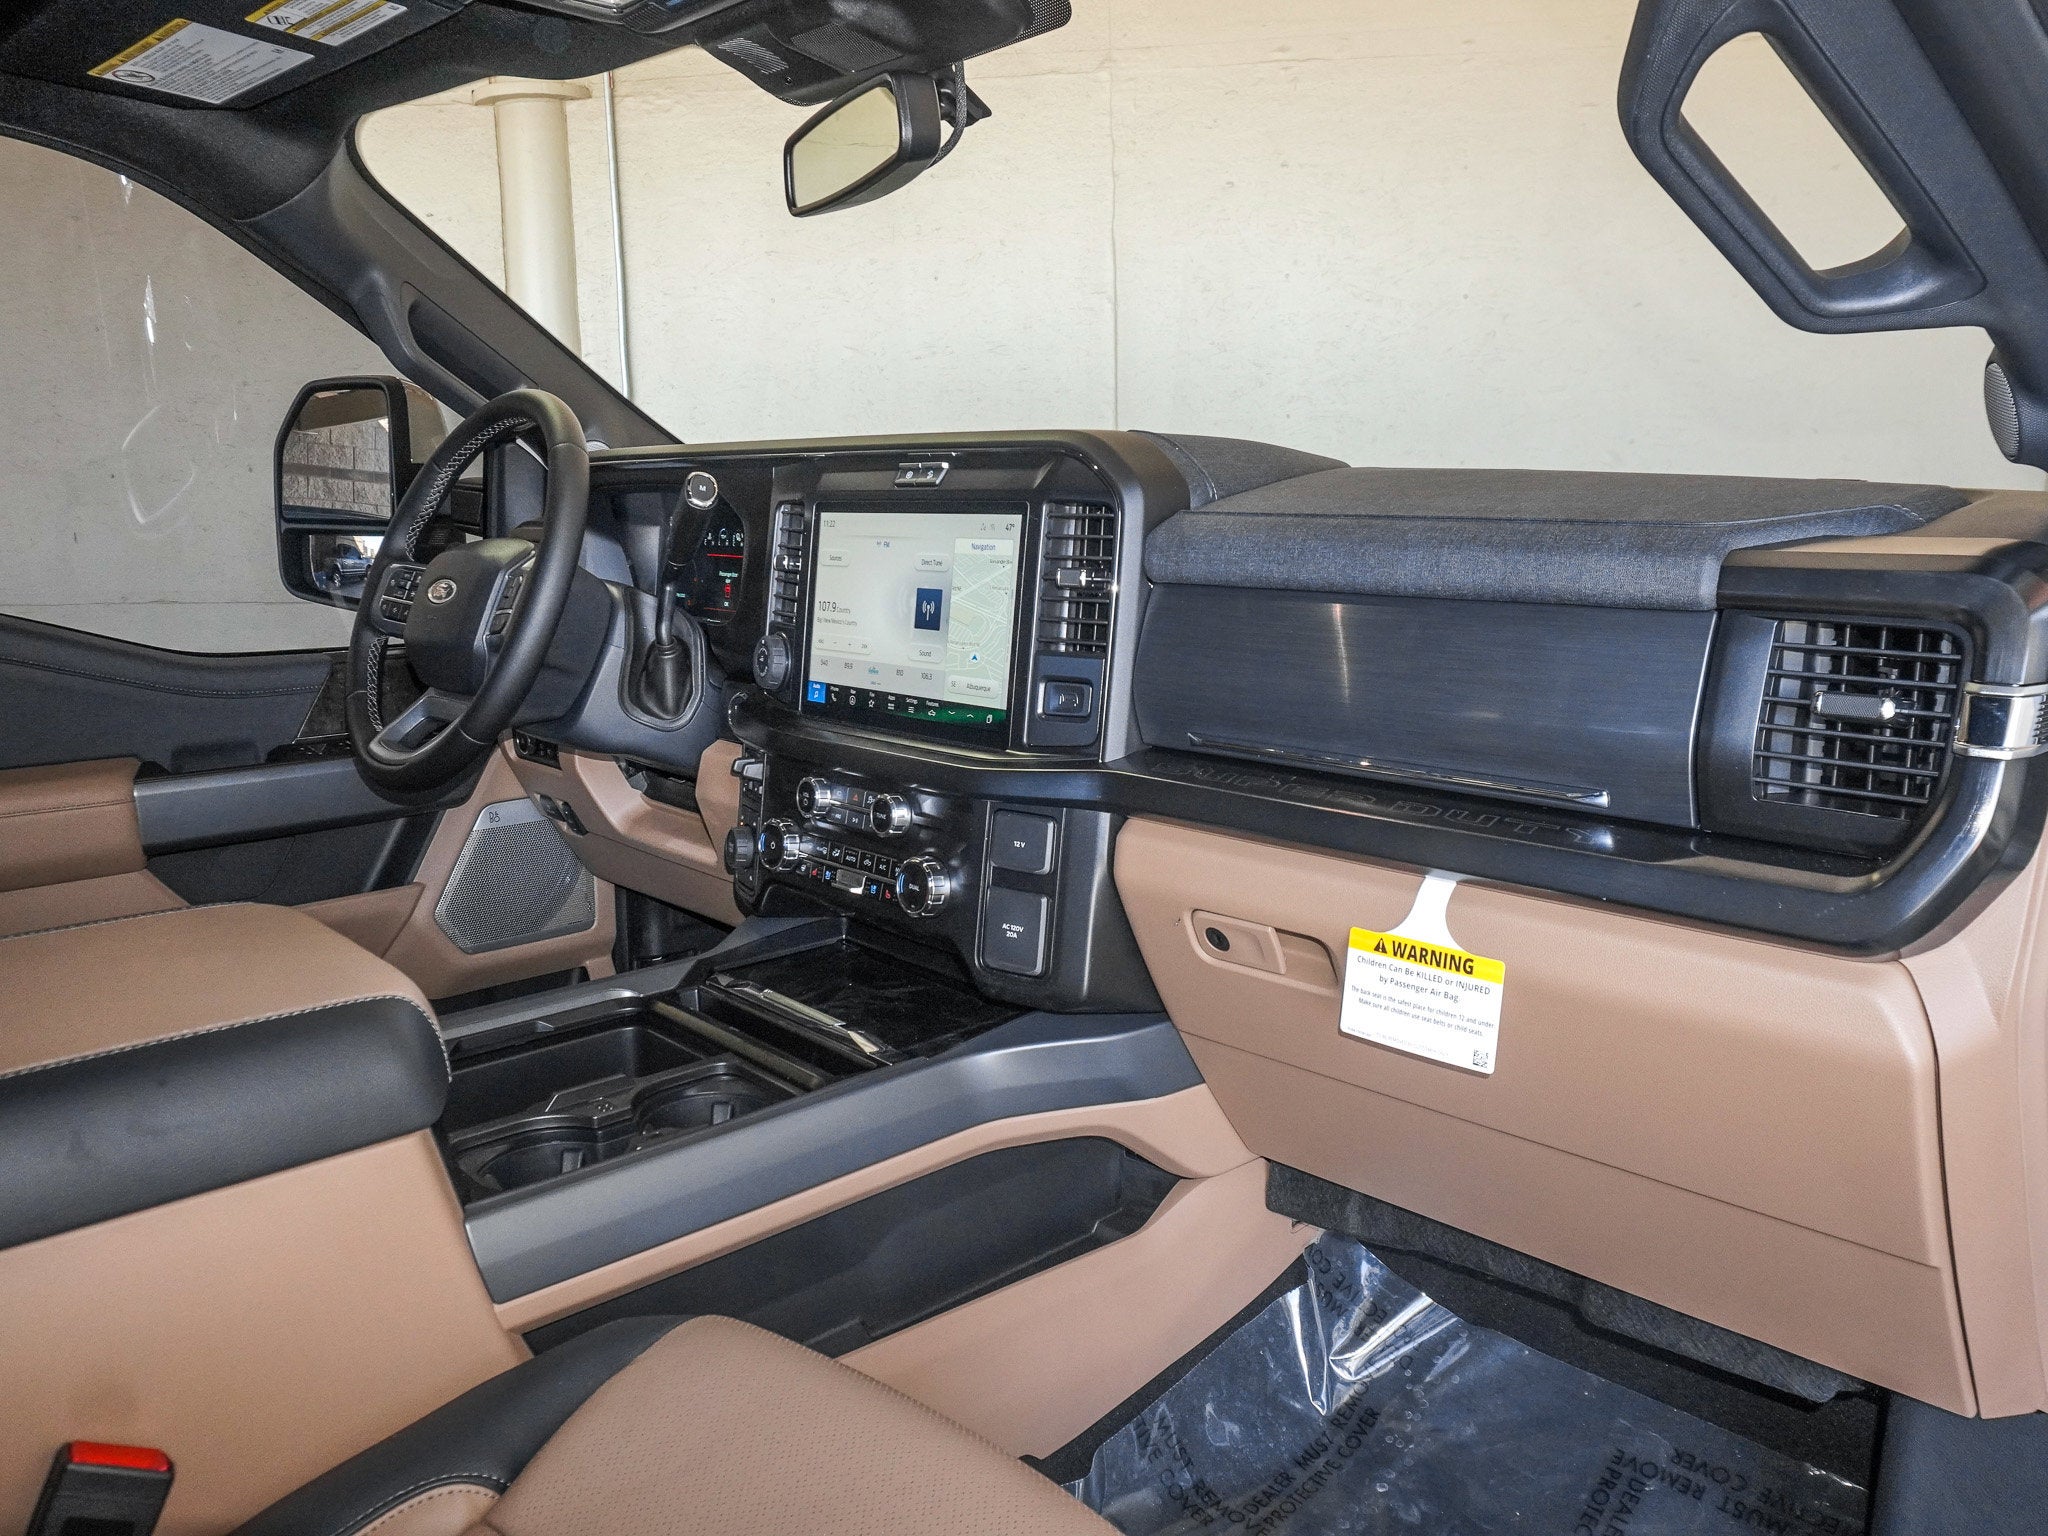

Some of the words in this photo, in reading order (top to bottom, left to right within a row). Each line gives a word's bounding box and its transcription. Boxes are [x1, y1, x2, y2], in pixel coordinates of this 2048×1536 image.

[971, 542, 996, 552] Navigation
[818, 600, 837, 613] 107.9
[919, 649, 932, 658] Sound
[1012, 840, 1026, 849] 12V
[1357, 955, 1387, 970] Children
[1389, 963, 1403, 974] Can
[1405, 967, 1415, 977] Be
[1416, 970, 1443, 984] KILLED
[1455, 980, 1491, 995] INJURED
[1391, 940, 1474, 975] WARNING
[1379, 973, 1388, 985] by
[1390, 977, 1428, 994] Passenger
[1430, 987, 1441, 997] Air
[1358, 997, 1372, 1006] Make
[1372, 1002, 1383, 1010] sure
[1391, 1006, 1410, 1017] children
[1421, 1015, 1432, 1024] seat
[1454, 1023, 1468, 1033] child
[1372, 991, 1382, 999] seat
[1397, 999, 1412, 1008] safest
[1412, 1002, 1426, 1011] place
[1436, 1008, 1457, 1019] children
[1466, 1017, 1477, 1025] and
[1242, 1468, 1296, 1517] DEALER
[1293, 1430, 1334, 1470] MUST
[1263, 1455, 1342, 1530] PROTECTIVE
[1337, 1405, 1380, 1459] COVER
[1609, 1447, 1706, 1501] REMOVE
[1670, 1446, 1748, 1493] COVER
